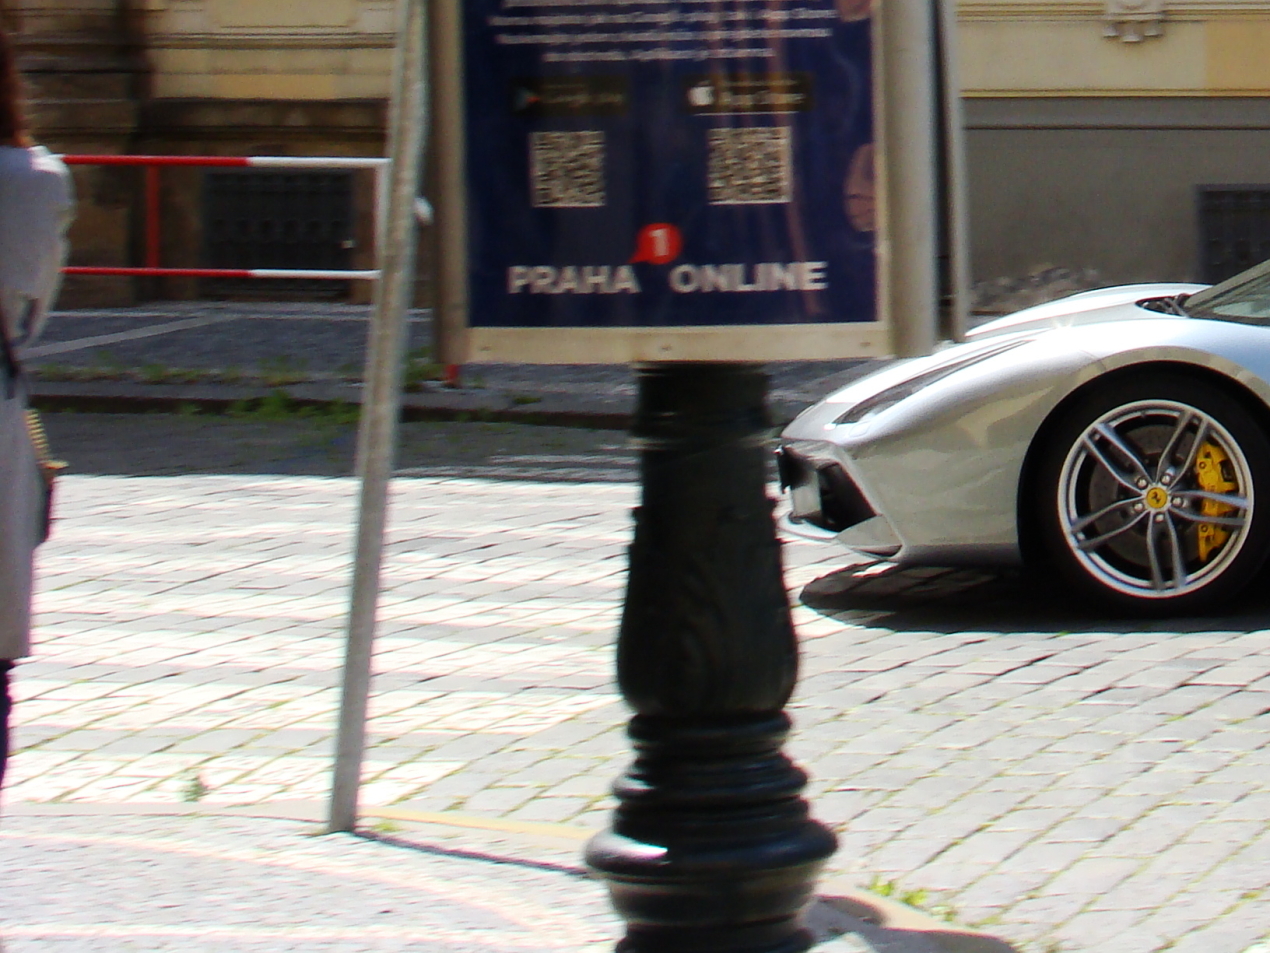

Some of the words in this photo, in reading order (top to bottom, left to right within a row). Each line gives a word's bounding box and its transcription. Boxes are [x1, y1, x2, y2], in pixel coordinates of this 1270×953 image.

[648, 228, 670, 257] 1
[507, 265, 639, 295] PRAHA
[669, 261, 829, 293] ONLINE
